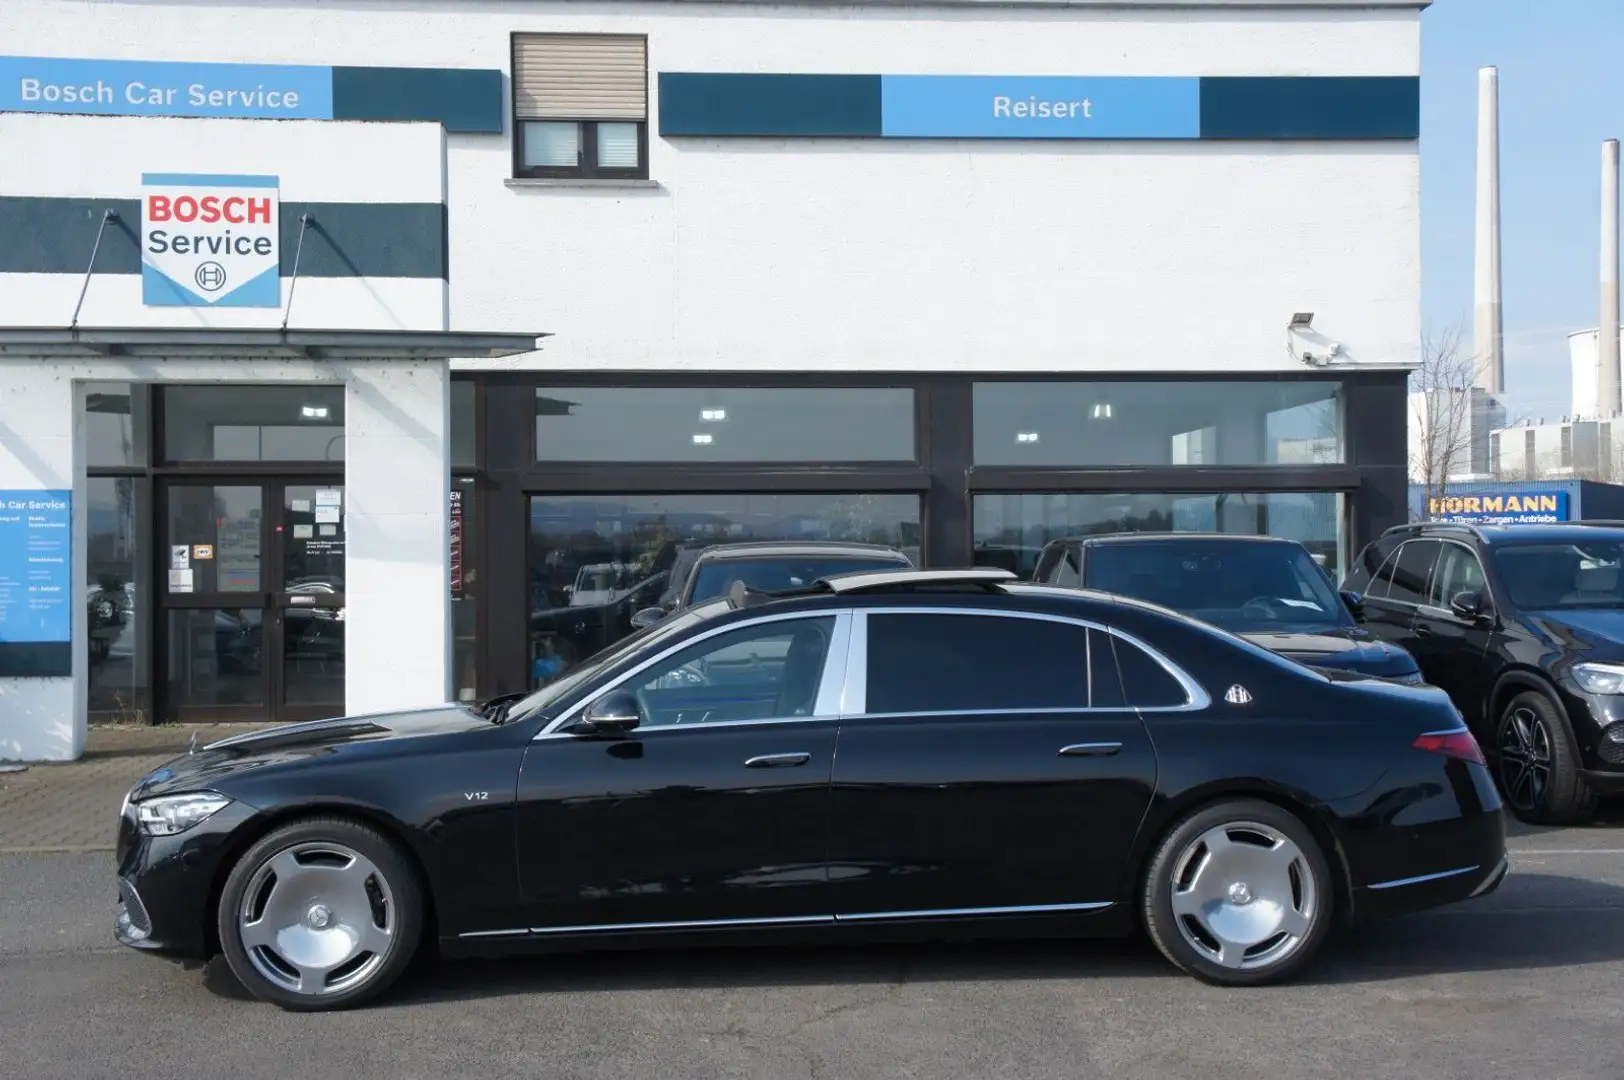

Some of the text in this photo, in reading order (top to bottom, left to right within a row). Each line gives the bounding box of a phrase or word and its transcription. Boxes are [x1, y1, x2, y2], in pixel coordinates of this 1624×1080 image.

[20, 78, 299, 109] Bosch Car Service
[993, 95, 1093, 118] Reisert
[148, 195, 271, 224] BOSCH
[148, 230, 272, 256] Service
[8, 501, 26, 510] Car
[28, 500, 66, 510] Service
[1482, 515, 1514, 525] Zargen
[1518, 514, 1557, 523] Antriebe
[463, 791, 489, 801] V12
